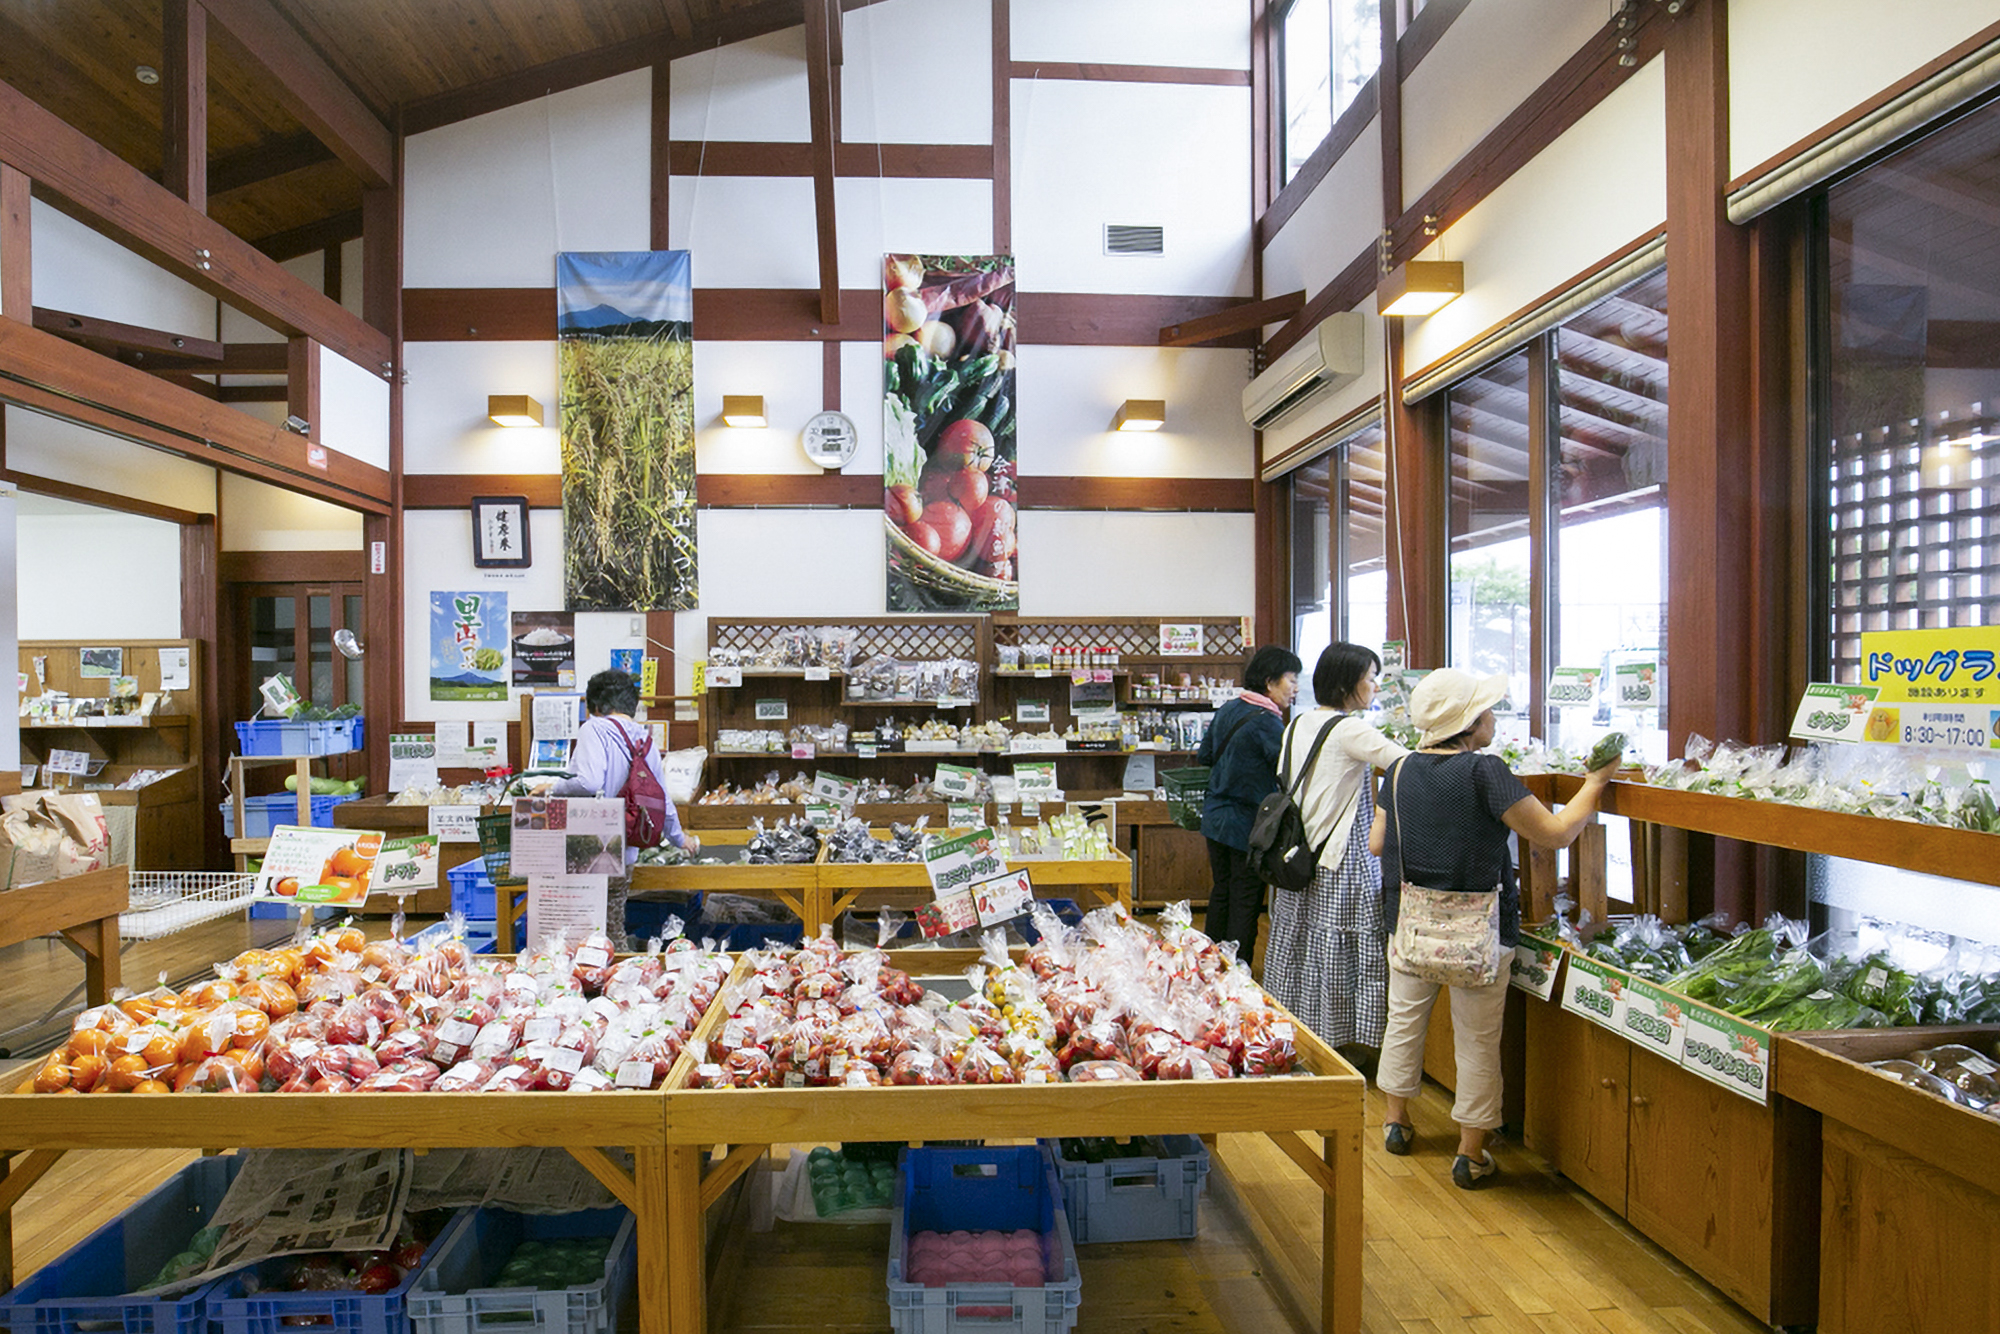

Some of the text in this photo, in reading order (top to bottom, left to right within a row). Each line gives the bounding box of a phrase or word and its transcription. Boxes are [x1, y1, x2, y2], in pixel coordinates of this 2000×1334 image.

[672, 489, 691, 593] 里山のつぶ
[1869, 649, 2000, 682] ドッグラ
[1907, 687, 1985, 698] 施設あります
[1922, 712, 1965, 723] 利用時間
[383, 861, 421, 883] トマト
